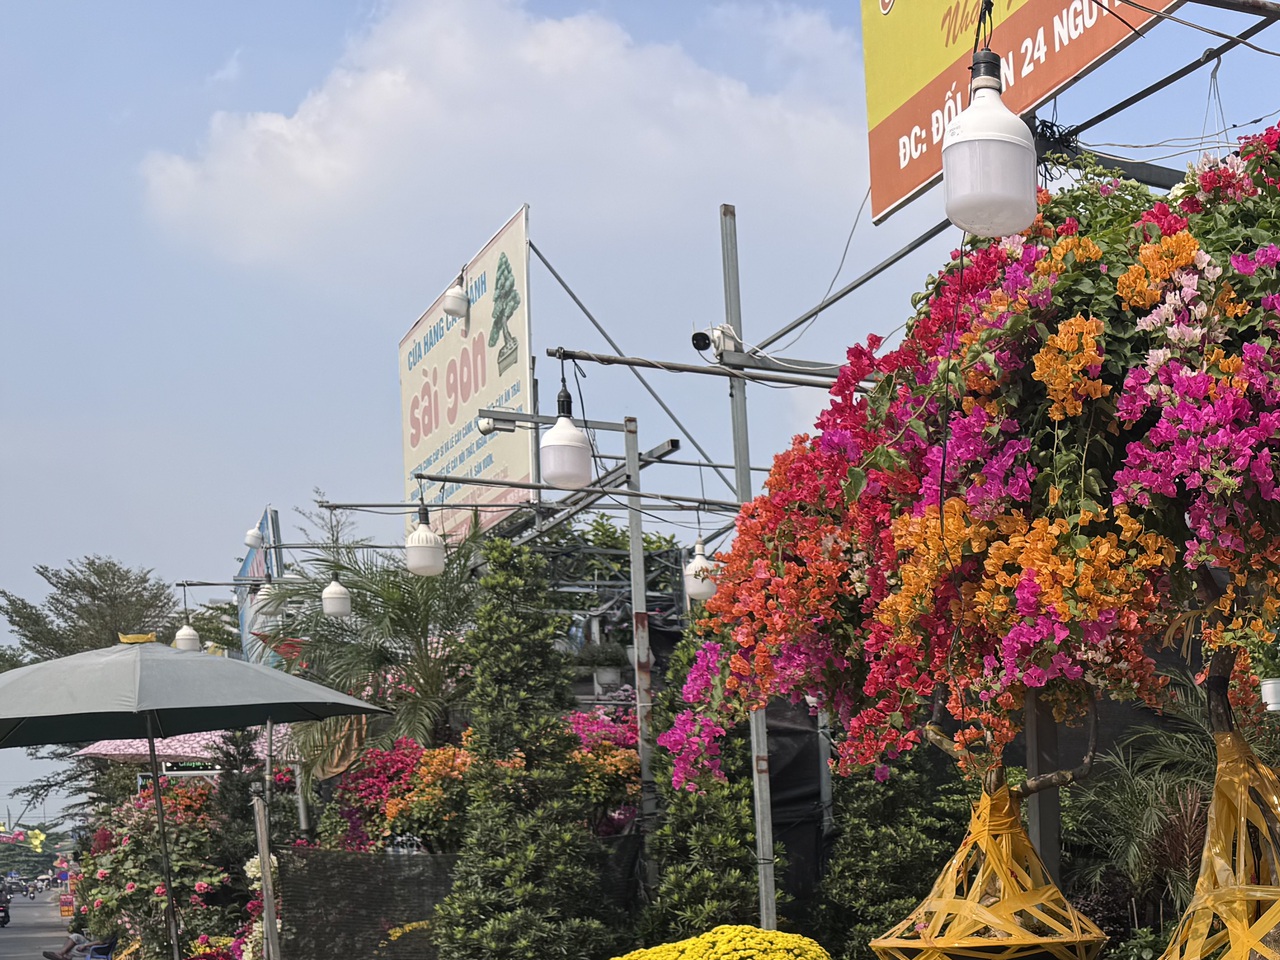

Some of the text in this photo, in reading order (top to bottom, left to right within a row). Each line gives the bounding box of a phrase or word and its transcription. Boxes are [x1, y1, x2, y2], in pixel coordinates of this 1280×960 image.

[899, 125, 926, 170] ĐC:
[1020, 27, 1047, 78] 24
[423, 317, 444, 355] HÀNG
[467, 271, 487, 308] ẢNH
[410, 329, 486, 449] sài gòn
